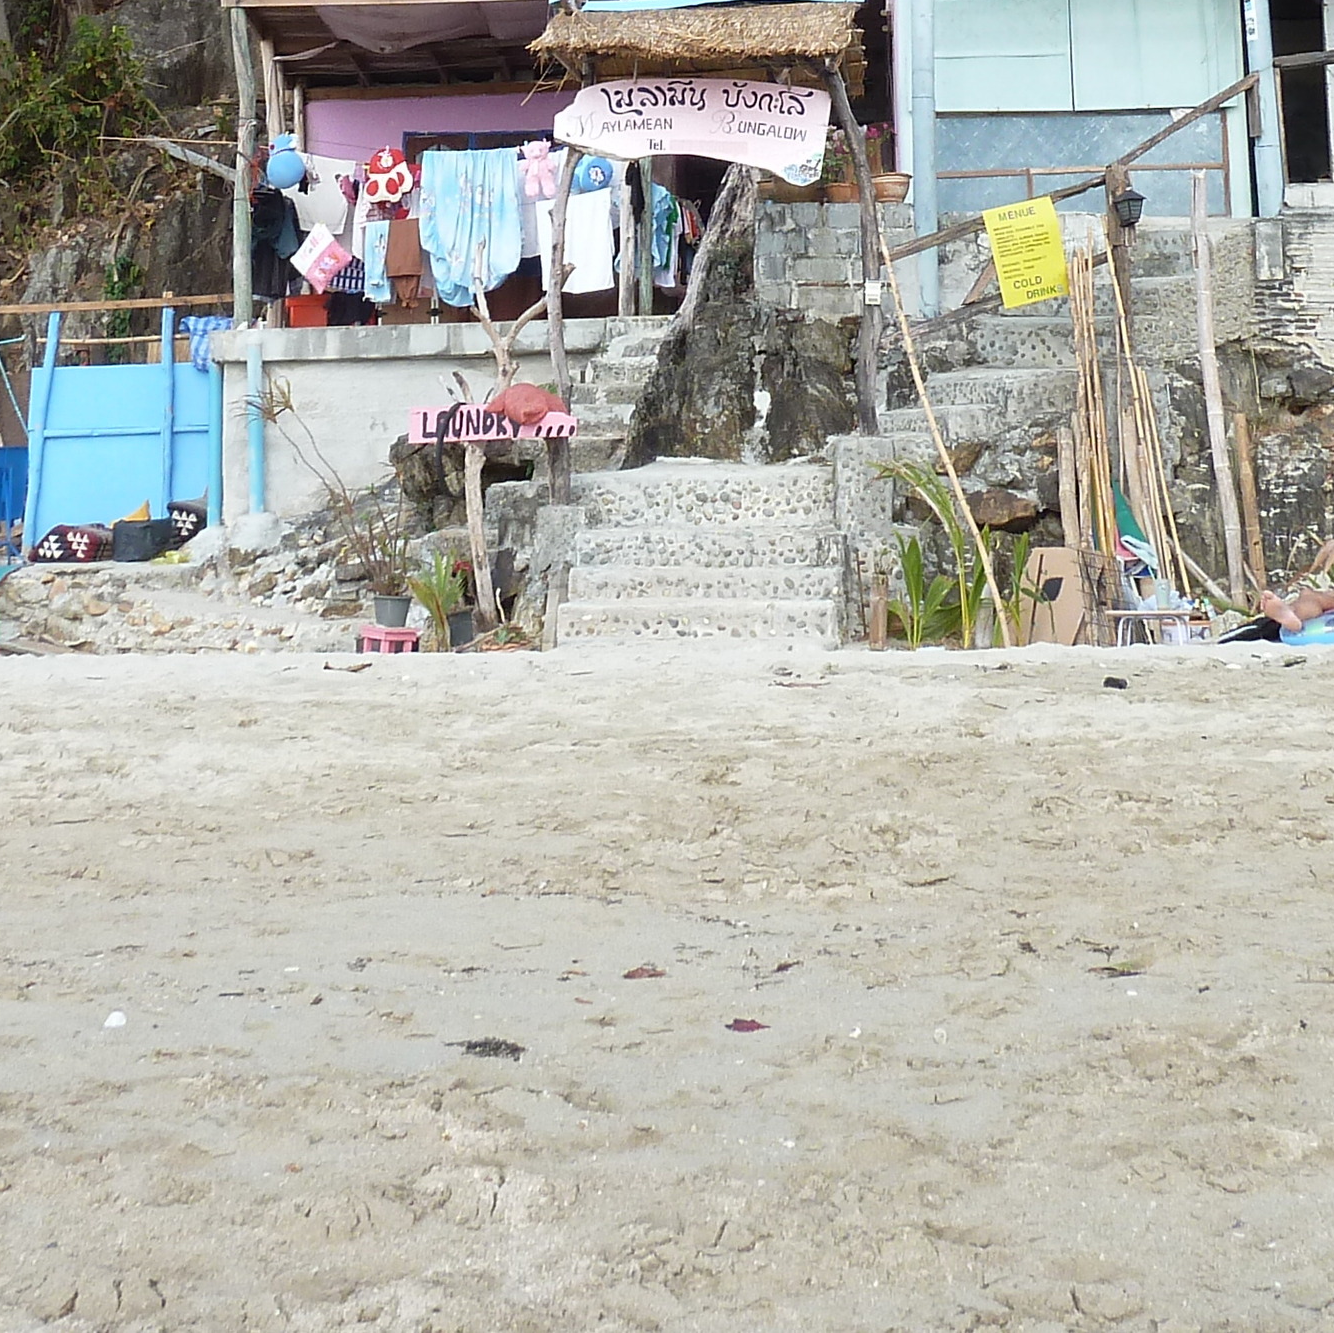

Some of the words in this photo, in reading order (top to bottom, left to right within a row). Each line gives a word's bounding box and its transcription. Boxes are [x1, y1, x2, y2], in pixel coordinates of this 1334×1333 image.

[710, 109, 807, 142] BUNGALOW
[998, 206, 1036, 222] MENUE
[1013, 275, 1042, 290] COLD
[1026, 283, 1064, 300] DRINKS
